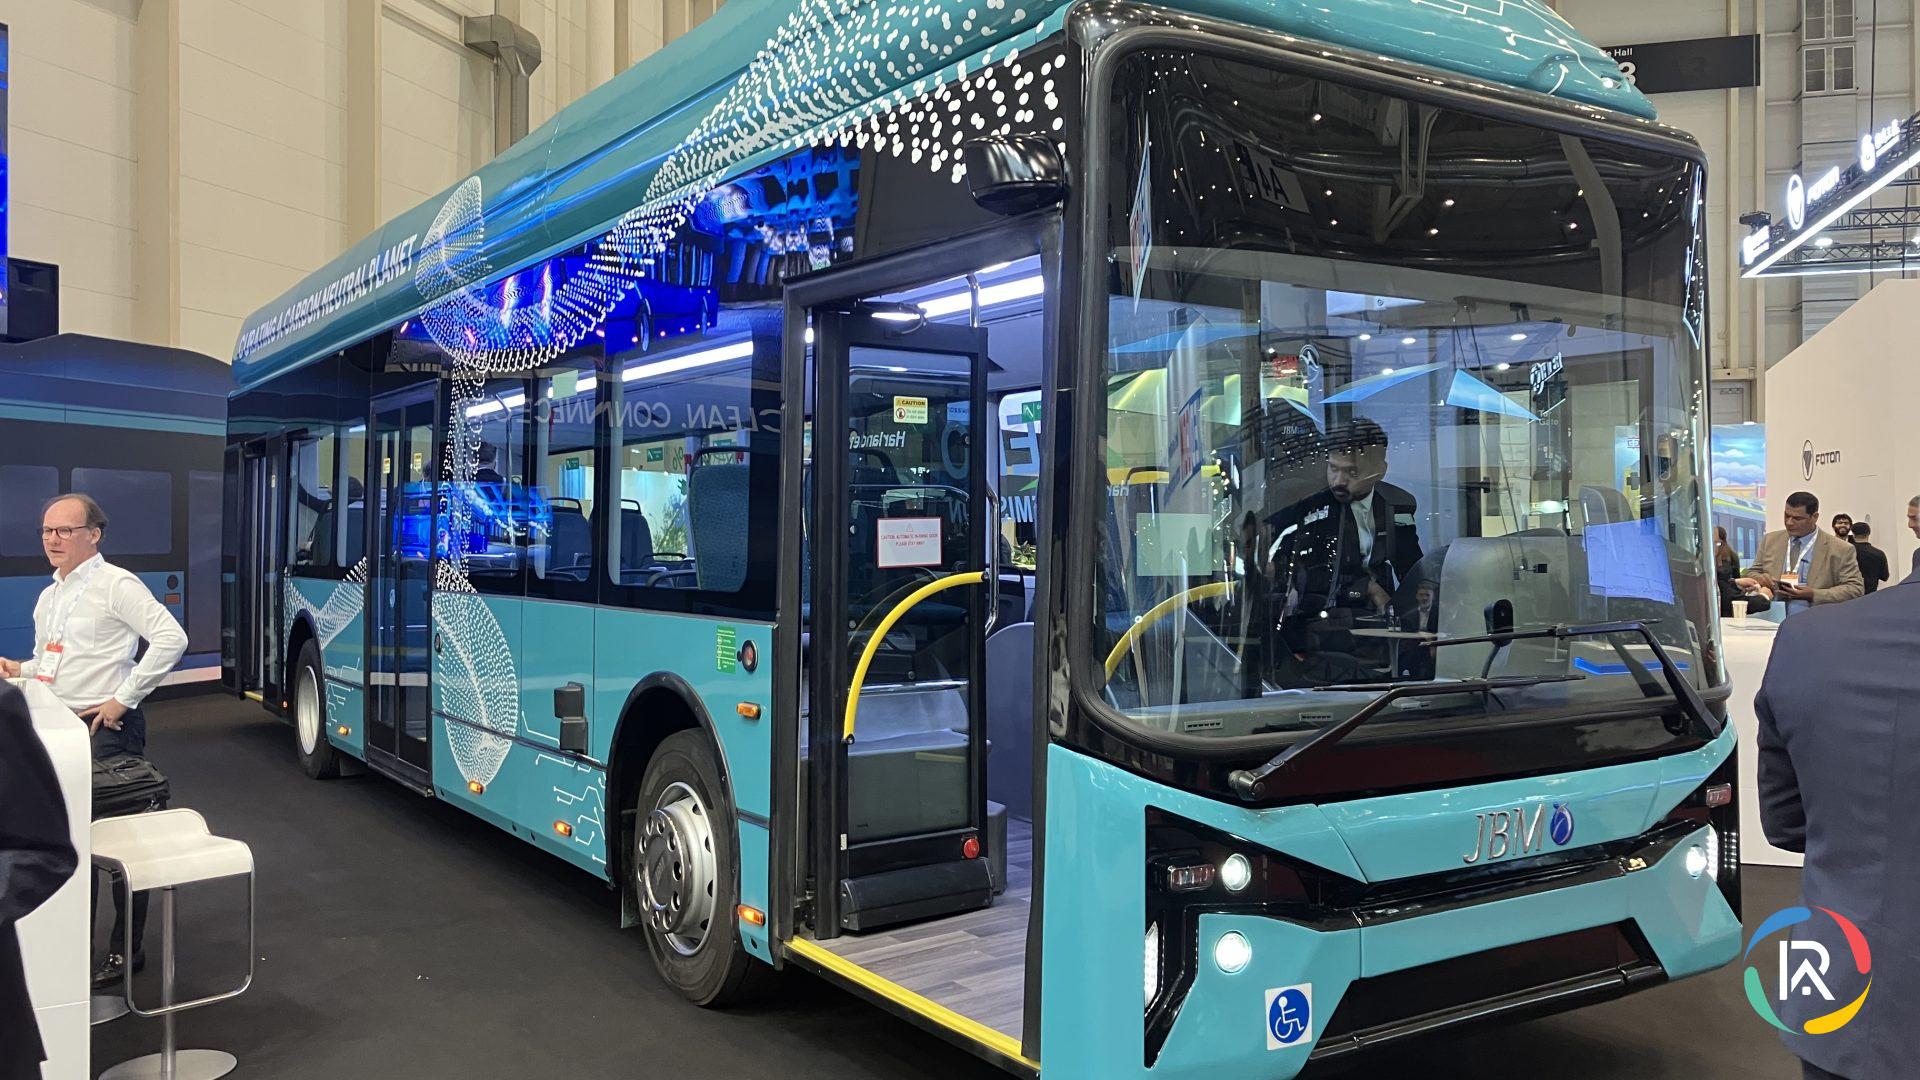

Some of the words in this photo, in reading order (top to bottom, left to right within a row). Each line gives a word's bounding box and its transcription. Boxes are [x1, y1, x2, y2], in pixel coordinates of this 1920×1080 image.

[1614, 48, 1633, 57] Hall
[237, 316, 277, 358] CURATING
[284, 291, 322, 332] CARBON
[321, 265, 367, 314] NEUTRAL
[367, 234, 418, 293] PLANET
[1815, 450, 1840, 466] FOTON
[1462, 803, 1546, 863] JBM
